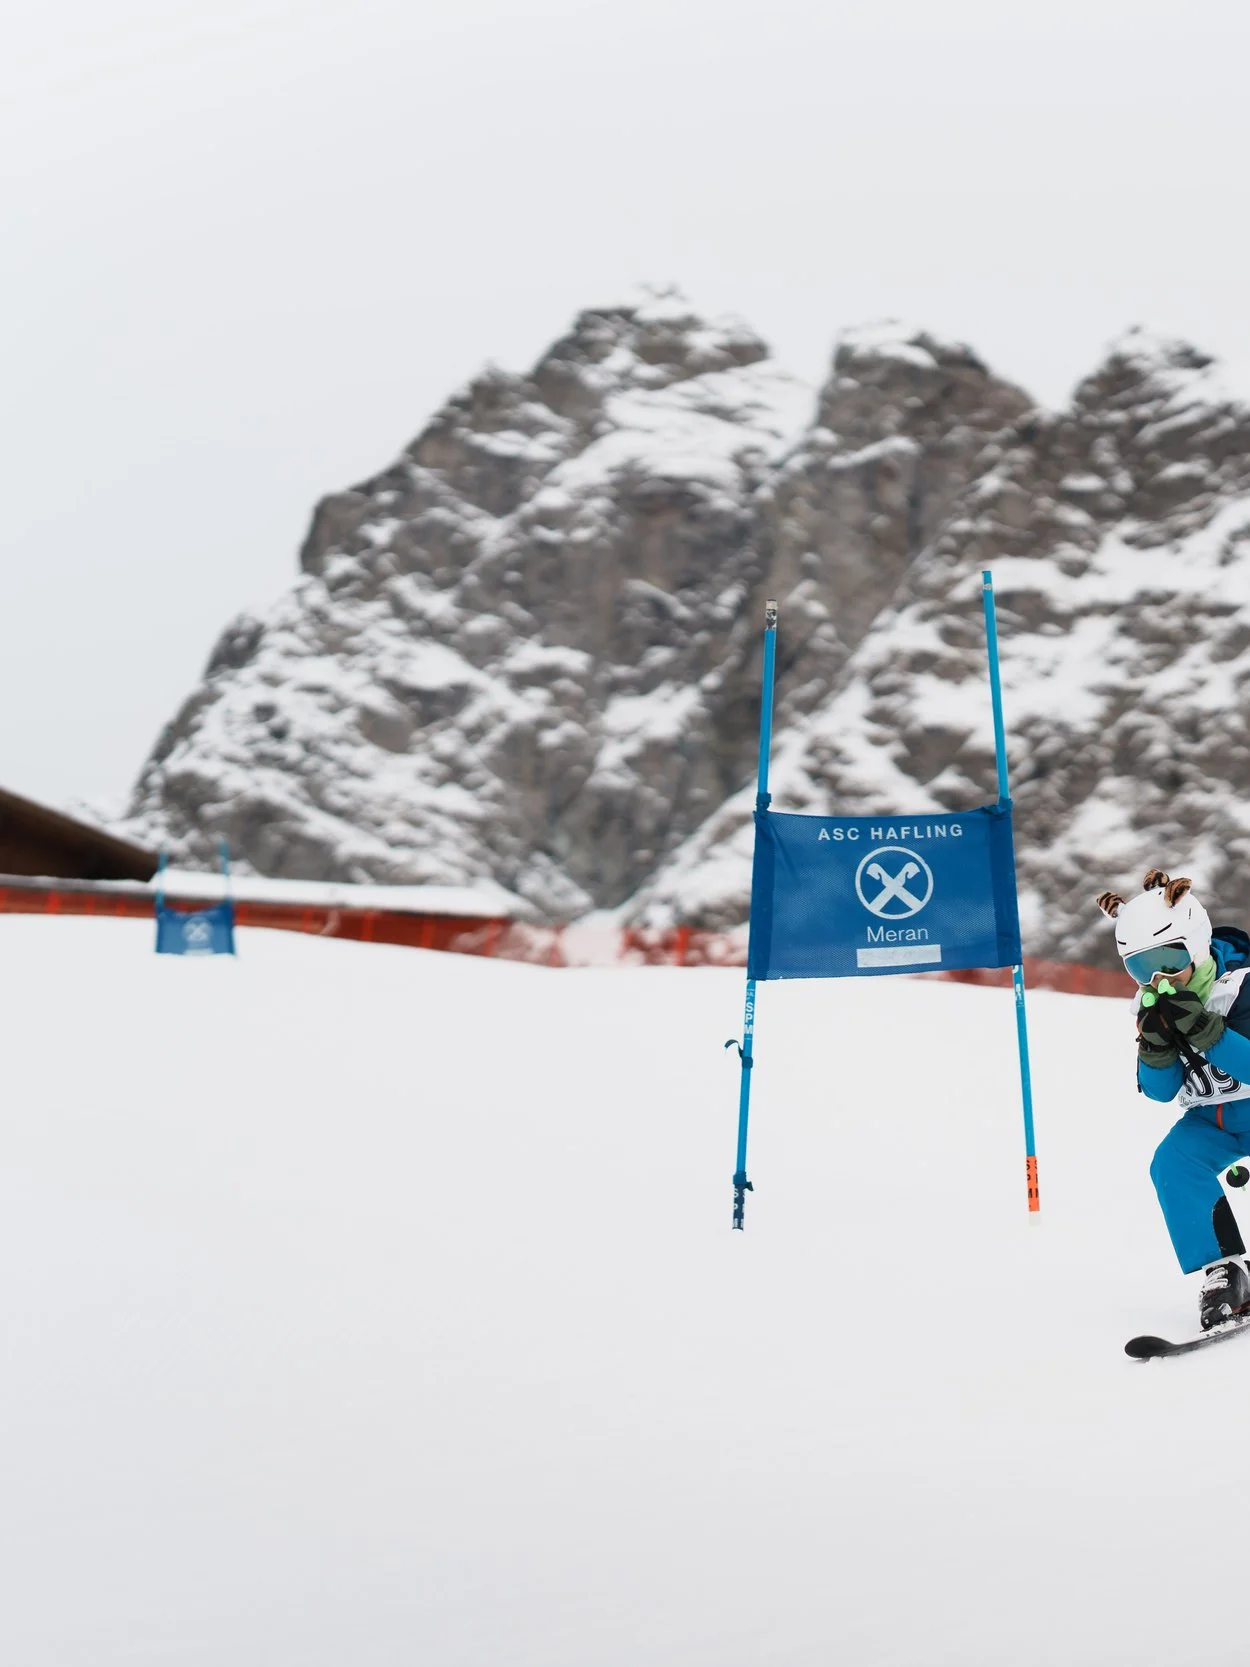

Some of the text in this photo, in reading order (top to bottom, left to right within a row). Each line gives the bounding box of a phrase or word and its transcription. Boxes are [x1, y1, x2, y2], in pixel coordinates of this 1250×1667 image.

[818, 824, 963, 841] ASC HAFLING
[867, 926, 929, 943] Meran
